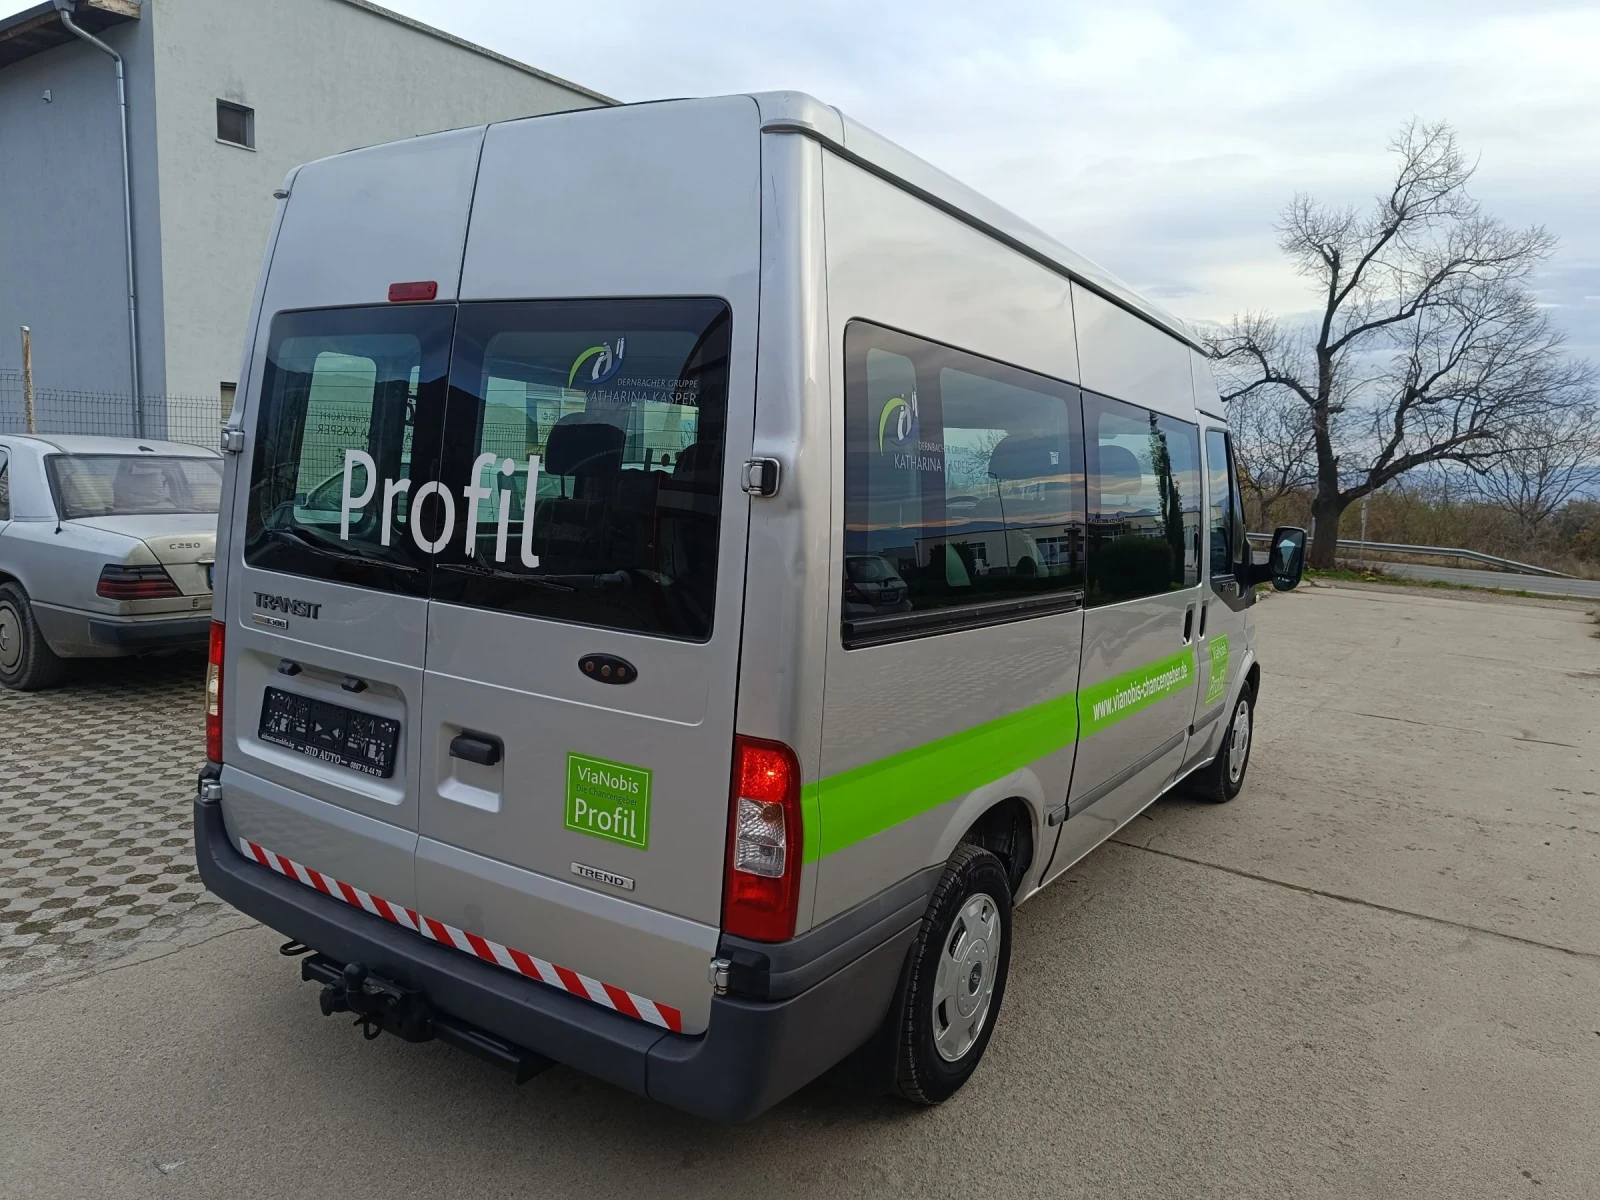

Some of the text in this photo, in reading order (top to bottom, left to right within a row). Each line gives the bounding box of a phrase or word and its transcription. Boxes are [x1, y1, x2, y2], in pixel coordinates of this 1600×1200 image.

[617, 378, 699, 389] DERNBACHER GRUPPE
[584, 390, 697, 406] KATHARINA KASPER
[893, 453, 943, 473] KATHARINA
[339, 448, 542, 569] Profil
[252, 591, 323, 620] TRANSIT
[319, 751, 341, 765] AUTO
[577, 765, 640, 795] ViaNobis
[576, 783, 638, 806] Die Chancengeber
[574, 797, 637, 839] Profil
[576, 866, 624, 887] TREND
